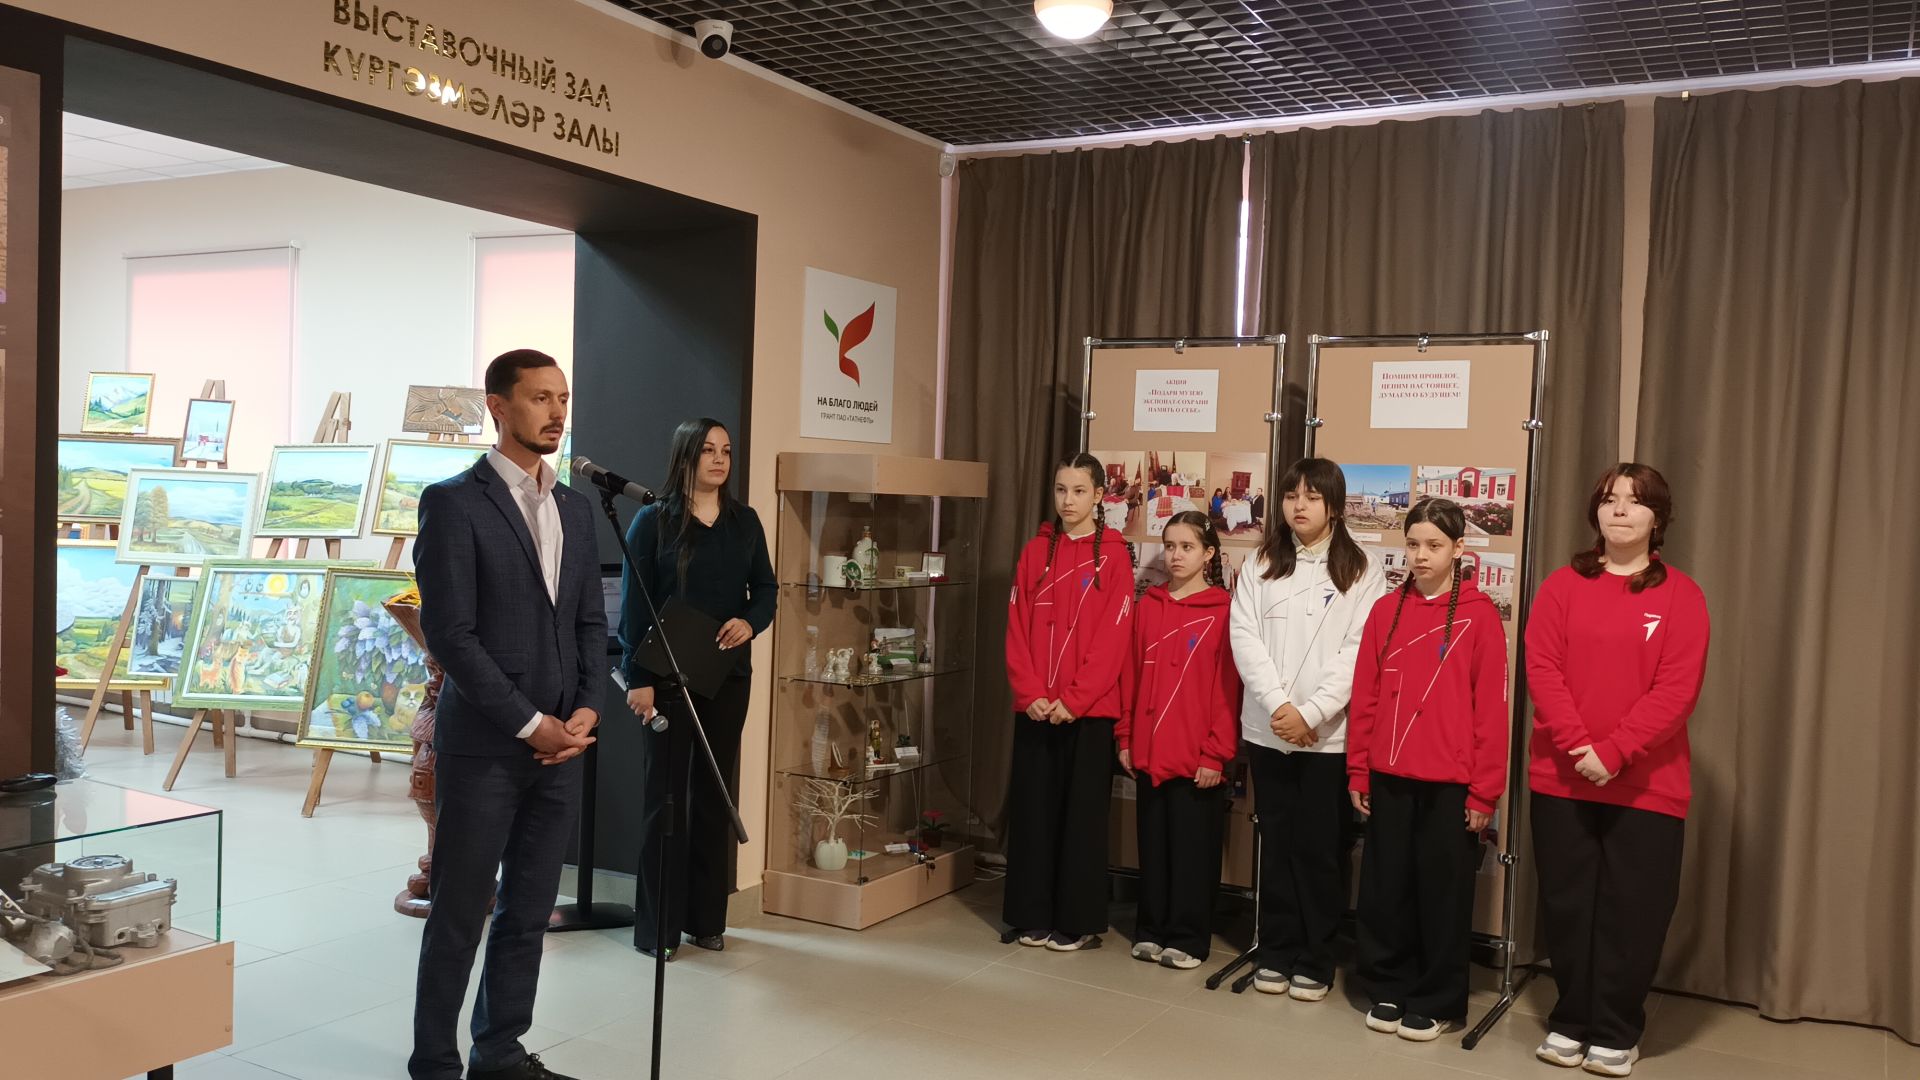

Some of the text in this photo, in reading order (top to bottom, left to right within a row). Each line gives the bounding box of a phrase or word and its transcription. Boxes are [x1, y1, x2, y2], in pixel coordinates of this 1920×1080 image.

[334, 0, 611, 112] ВЫСТАВОЧНЫЙ ЗАЛ
[553, 113, 619, 157] ЗАЛЫ
[818, 396, 878, 412] НА БЛАГО ЛЮДЕЙ
